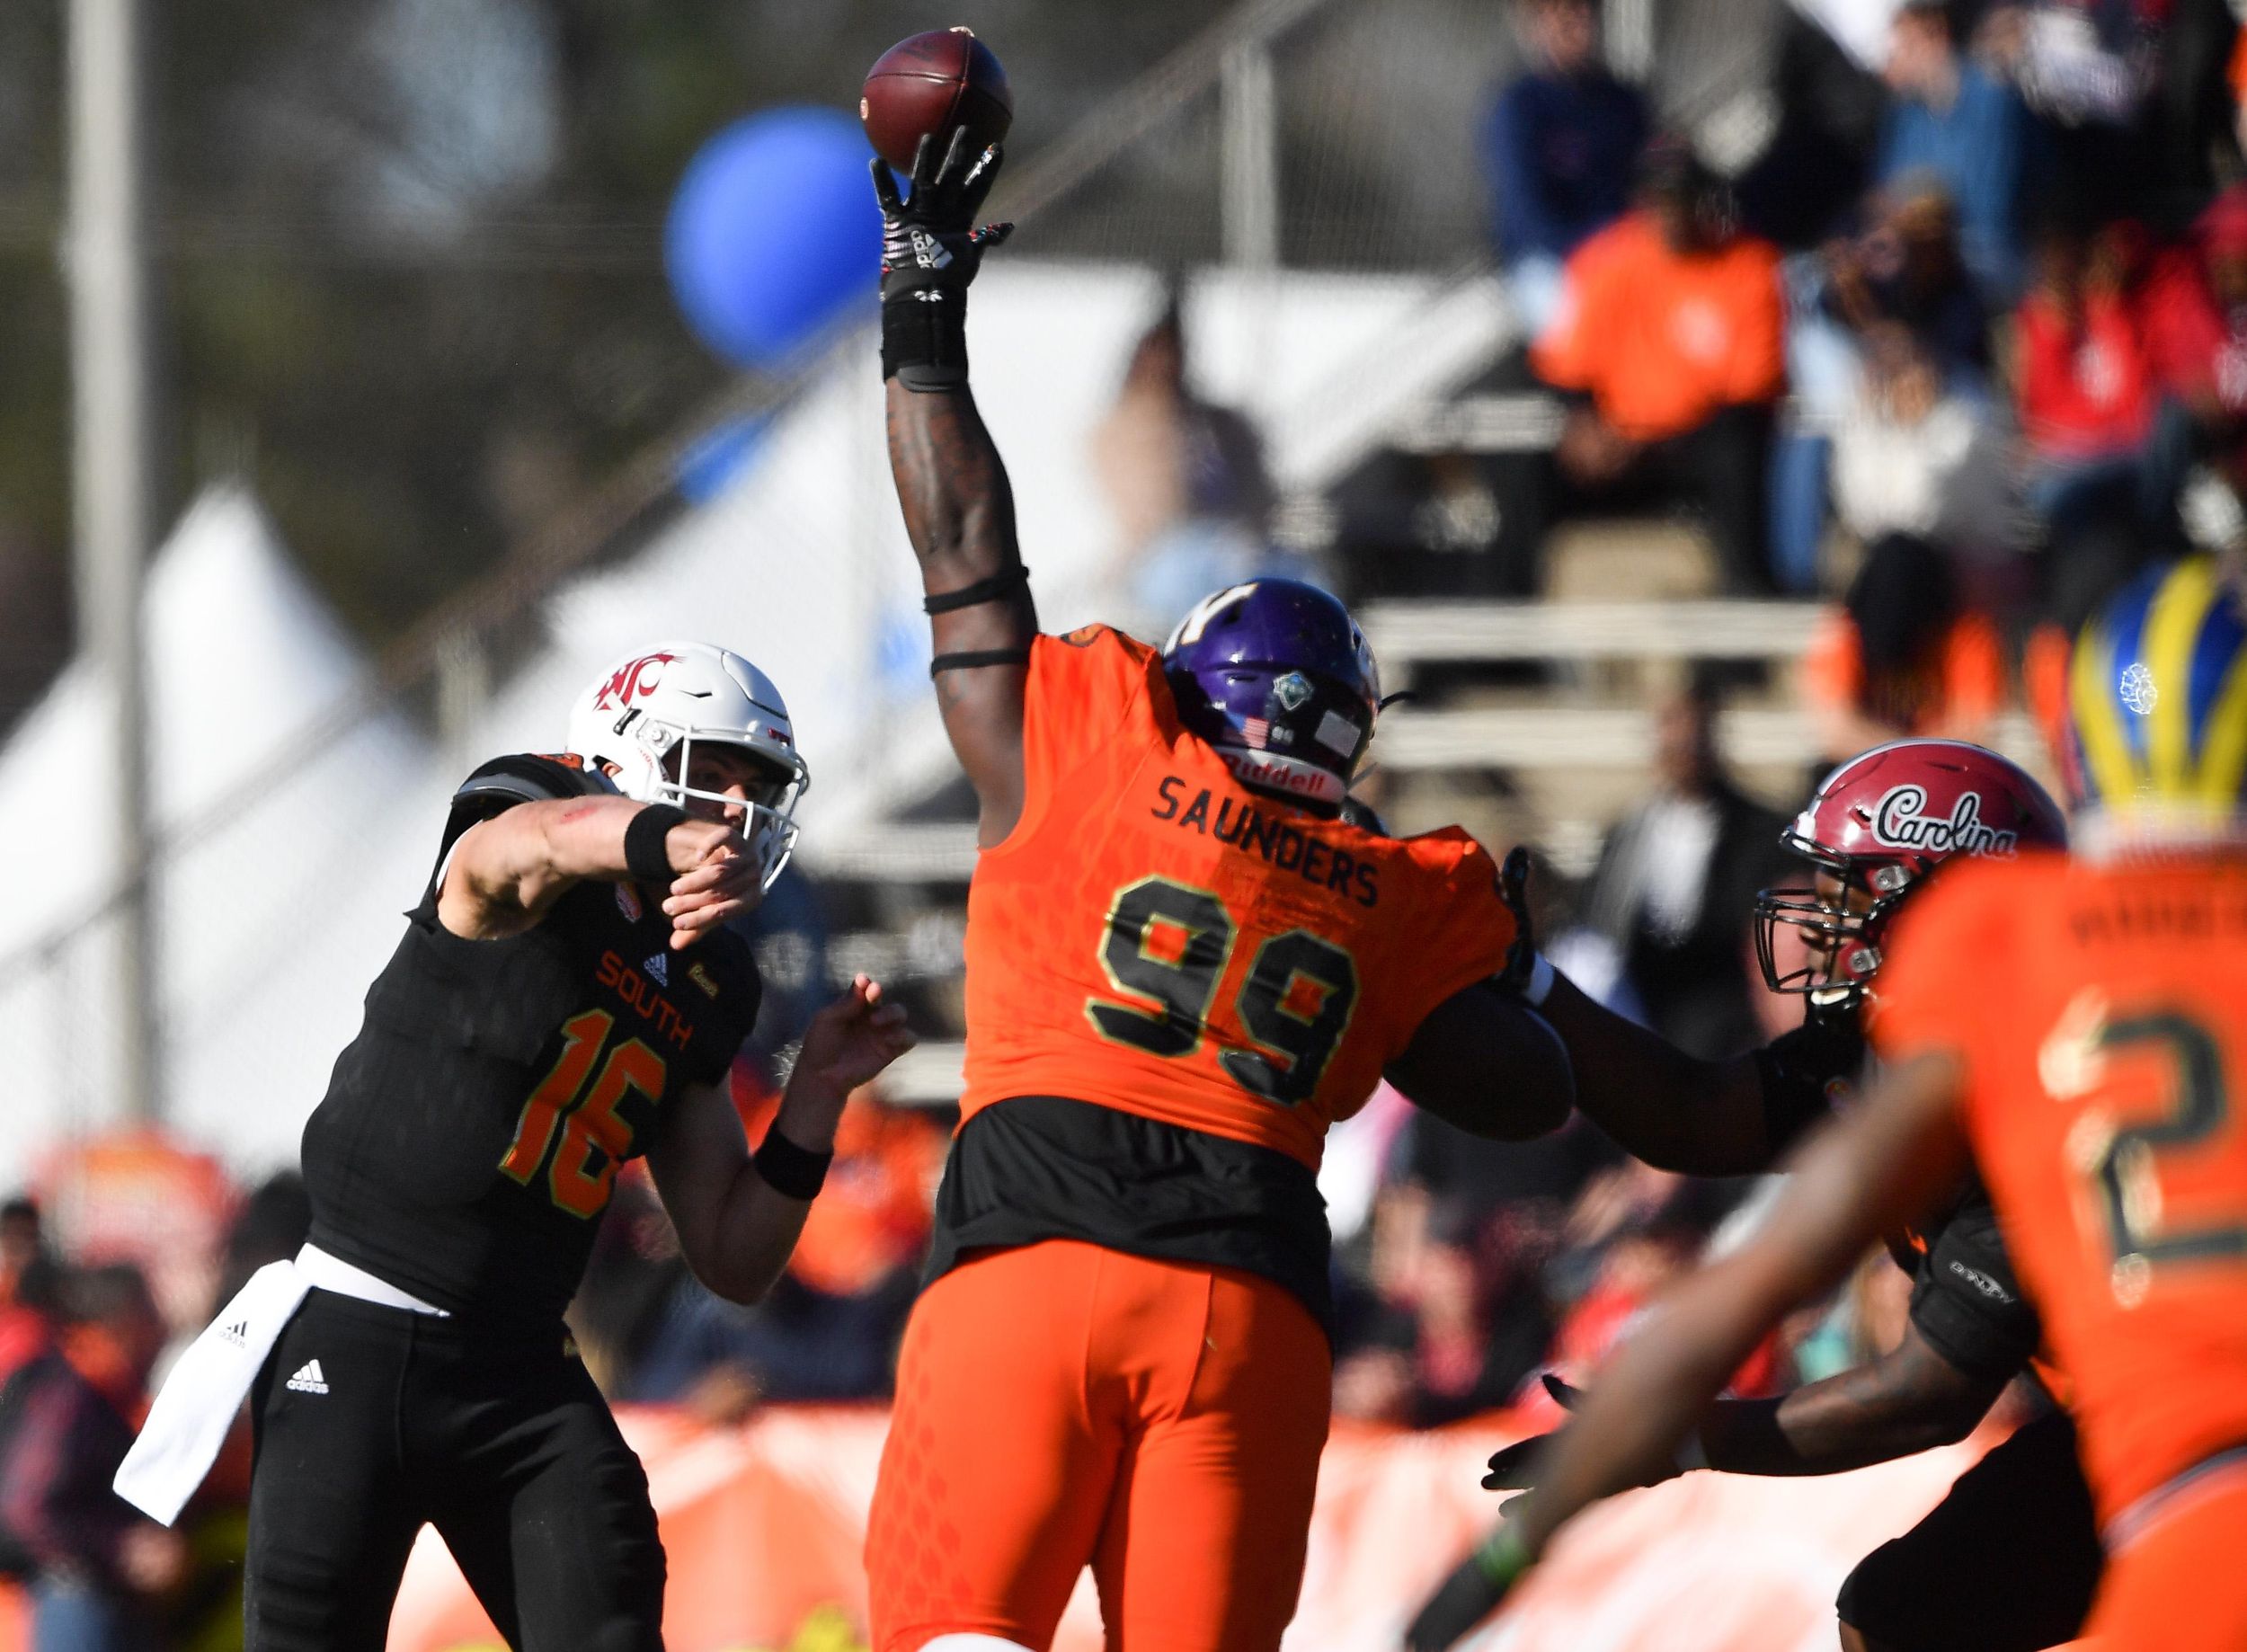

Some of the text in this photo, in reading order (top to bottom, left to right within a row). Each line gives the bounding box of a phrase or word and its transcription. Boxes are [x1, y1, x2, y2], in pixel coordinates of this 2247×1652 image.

[1150, 767, 1379, 909] SAUNDERS
[1872, 784, 2019, 861] Carolina
[595, 948, 695, 1052] SOUTH
[1083, 873, 1362, 1108] 99
[498, 1008, 667, 1221] 16
[286, 1379, 330, 1395] adidas
